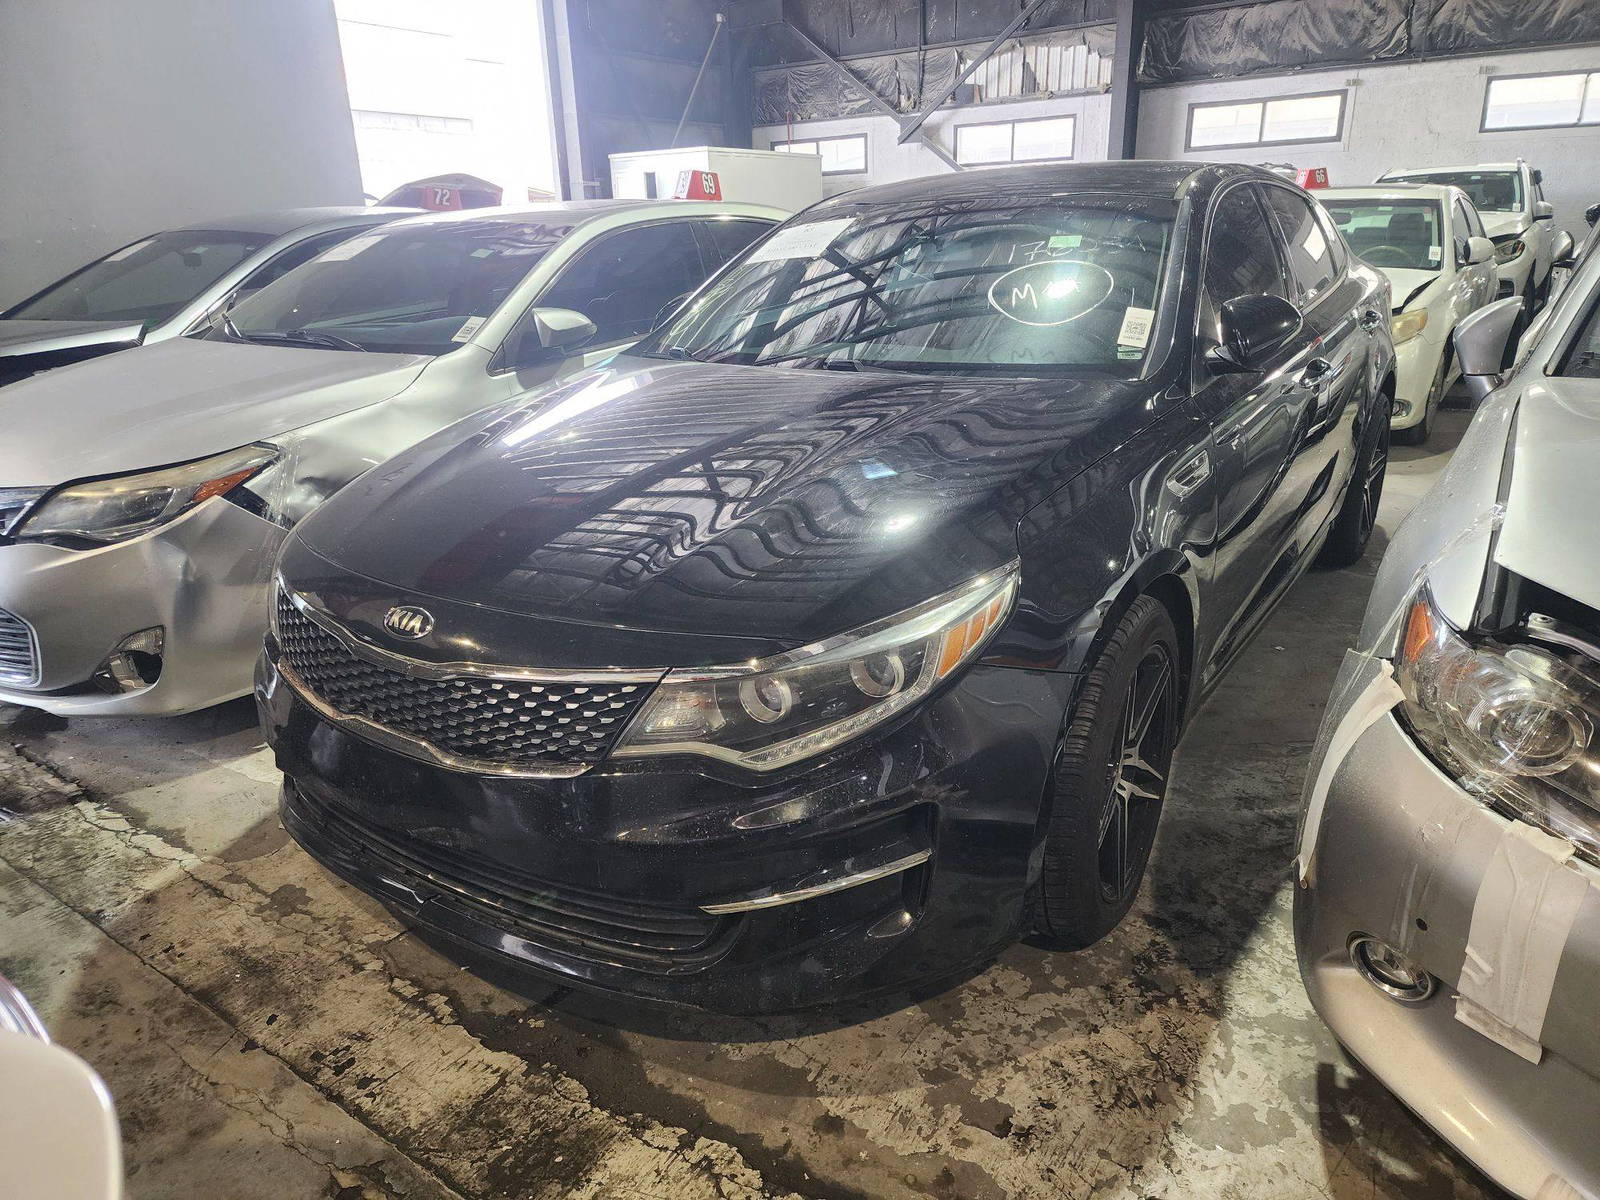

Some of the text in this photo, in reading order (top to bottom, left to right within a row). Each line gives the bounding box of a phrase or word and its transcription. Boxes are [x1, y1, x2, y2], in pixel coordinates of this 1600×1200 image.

[702, 172, 716, 195] 69
[1315, 169, 1325, 183] 66
[433, 188, 450, 206] 72
[388, 609, 424, 634] KIA
